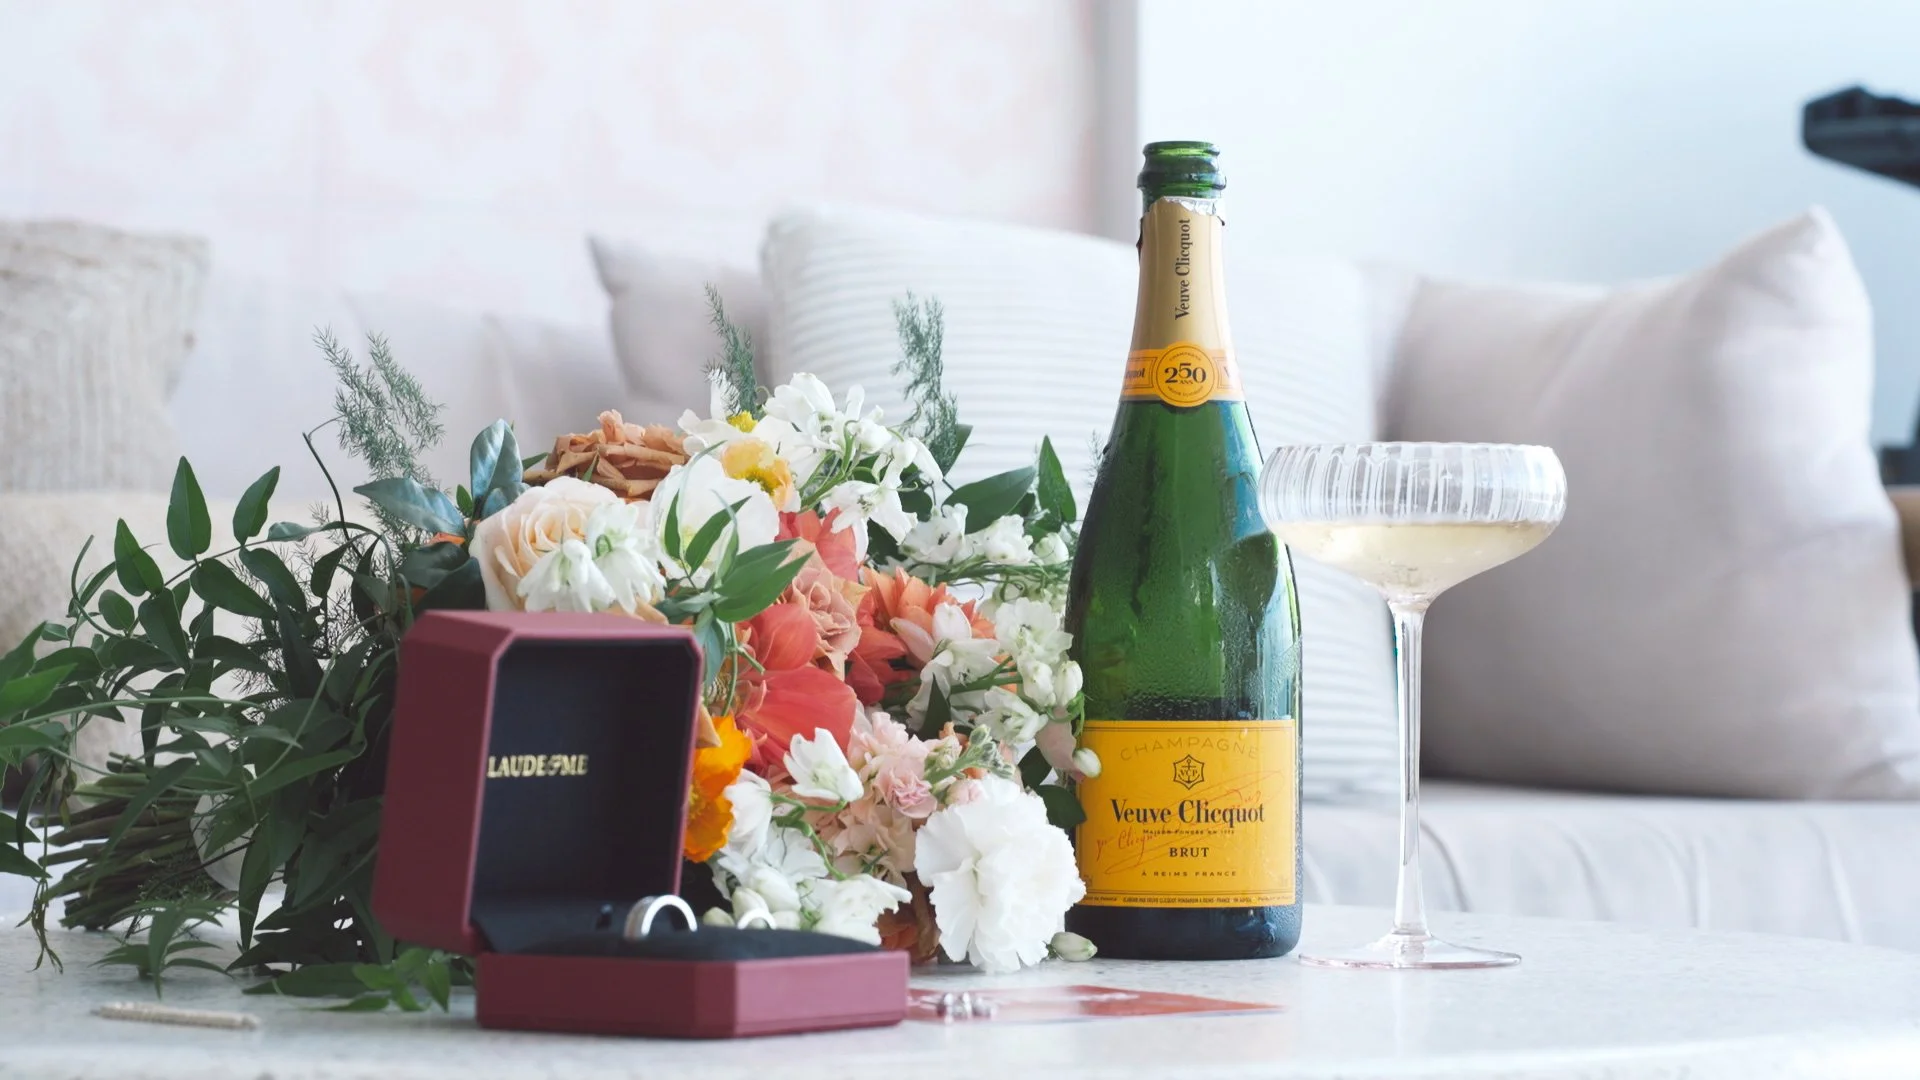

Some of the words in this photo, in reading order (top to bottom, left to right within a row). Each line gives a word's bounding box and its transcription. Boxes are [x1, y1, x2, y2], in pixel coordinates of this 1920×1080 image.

[1175, 219, 1193, 276] Clicquot
[1175, 280, 1190, 320] Veuve
[1164, 362, 1207, 384] 250
[1120, 736, 1260, 762] CHAMPAGNE
[1110, 799, 1172, 823] Veuve
[1178, 799, 1265, 828] Clicquot
[1169, 847, 1210, 858] BRUT
